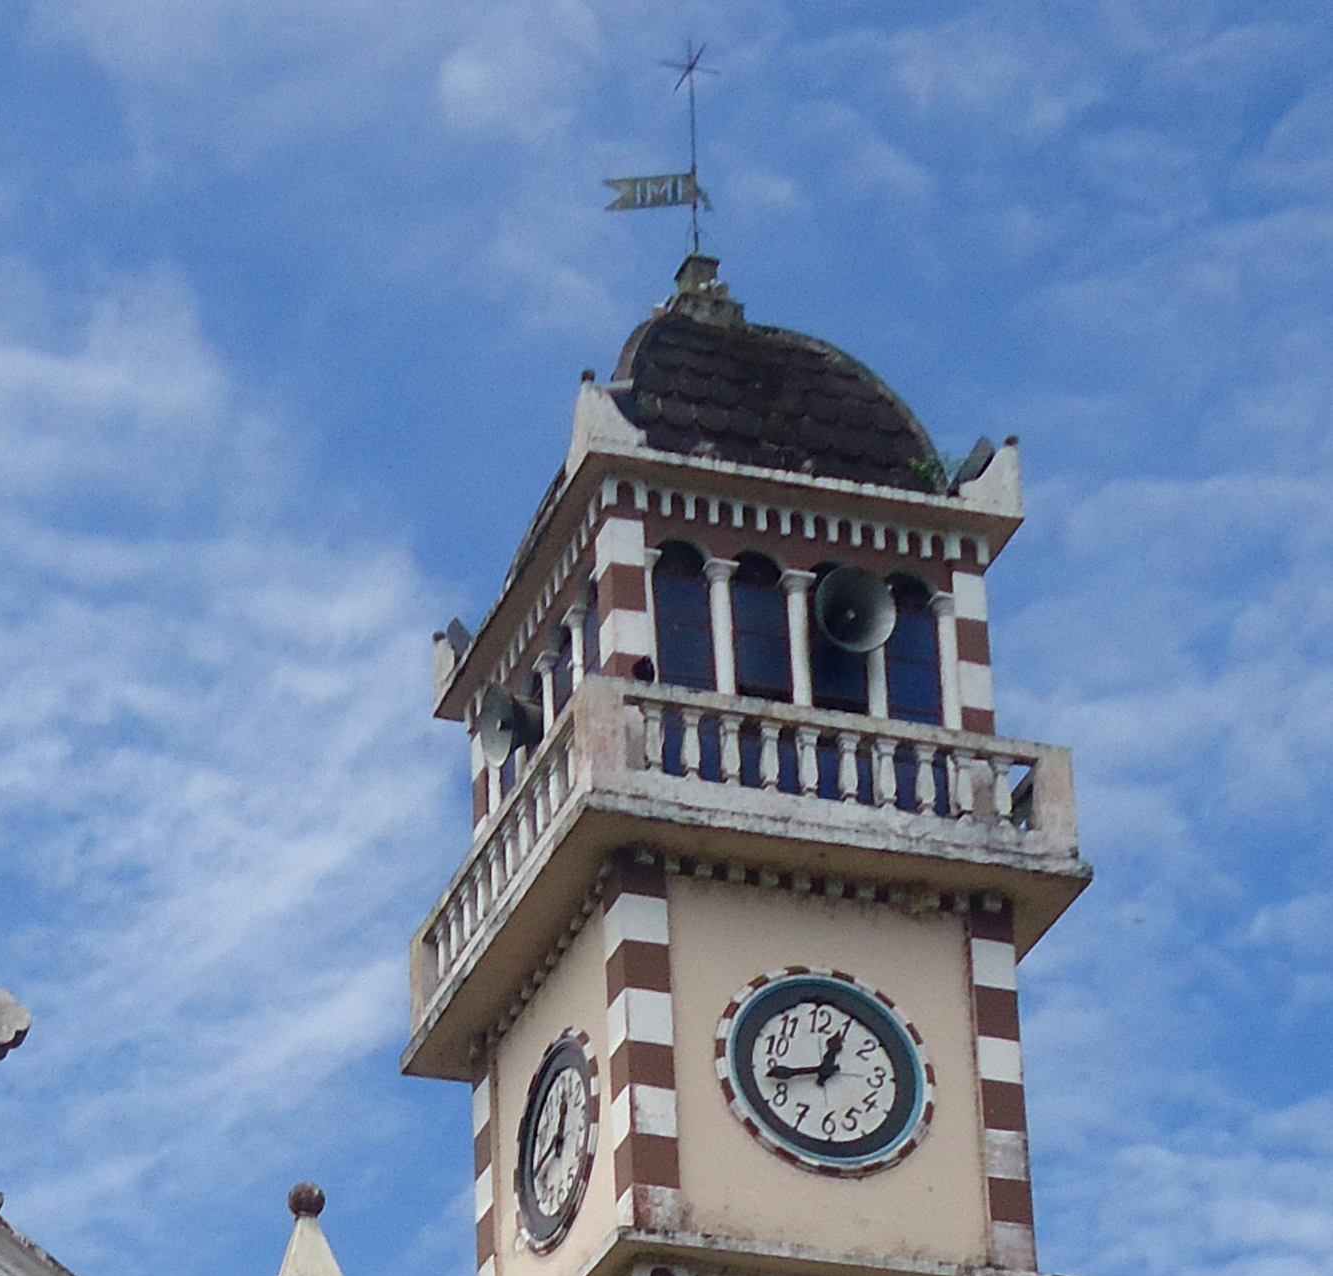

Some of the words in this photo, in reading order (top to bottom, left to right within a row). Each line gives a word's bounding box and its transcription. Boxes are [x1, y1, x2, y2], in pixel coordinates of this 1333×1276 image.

[780, 1014, 799, 1039] 11
[809, 1009, 831, 1035] 12
[841, 1018, 853, 1042] 1
[765, 1034, 789, 1058] 10
[855, 1038, 876, 1061] 2
[866, 1066, 886, 1088] 3
[773, 1082, 787, 1107] 8
[862, 1090, 879, 1113] 4
[796, 1102, 810, 1130] 7
[821, 1110, 836, 1135] 6
[841, 1106, 862, 1131] 5
